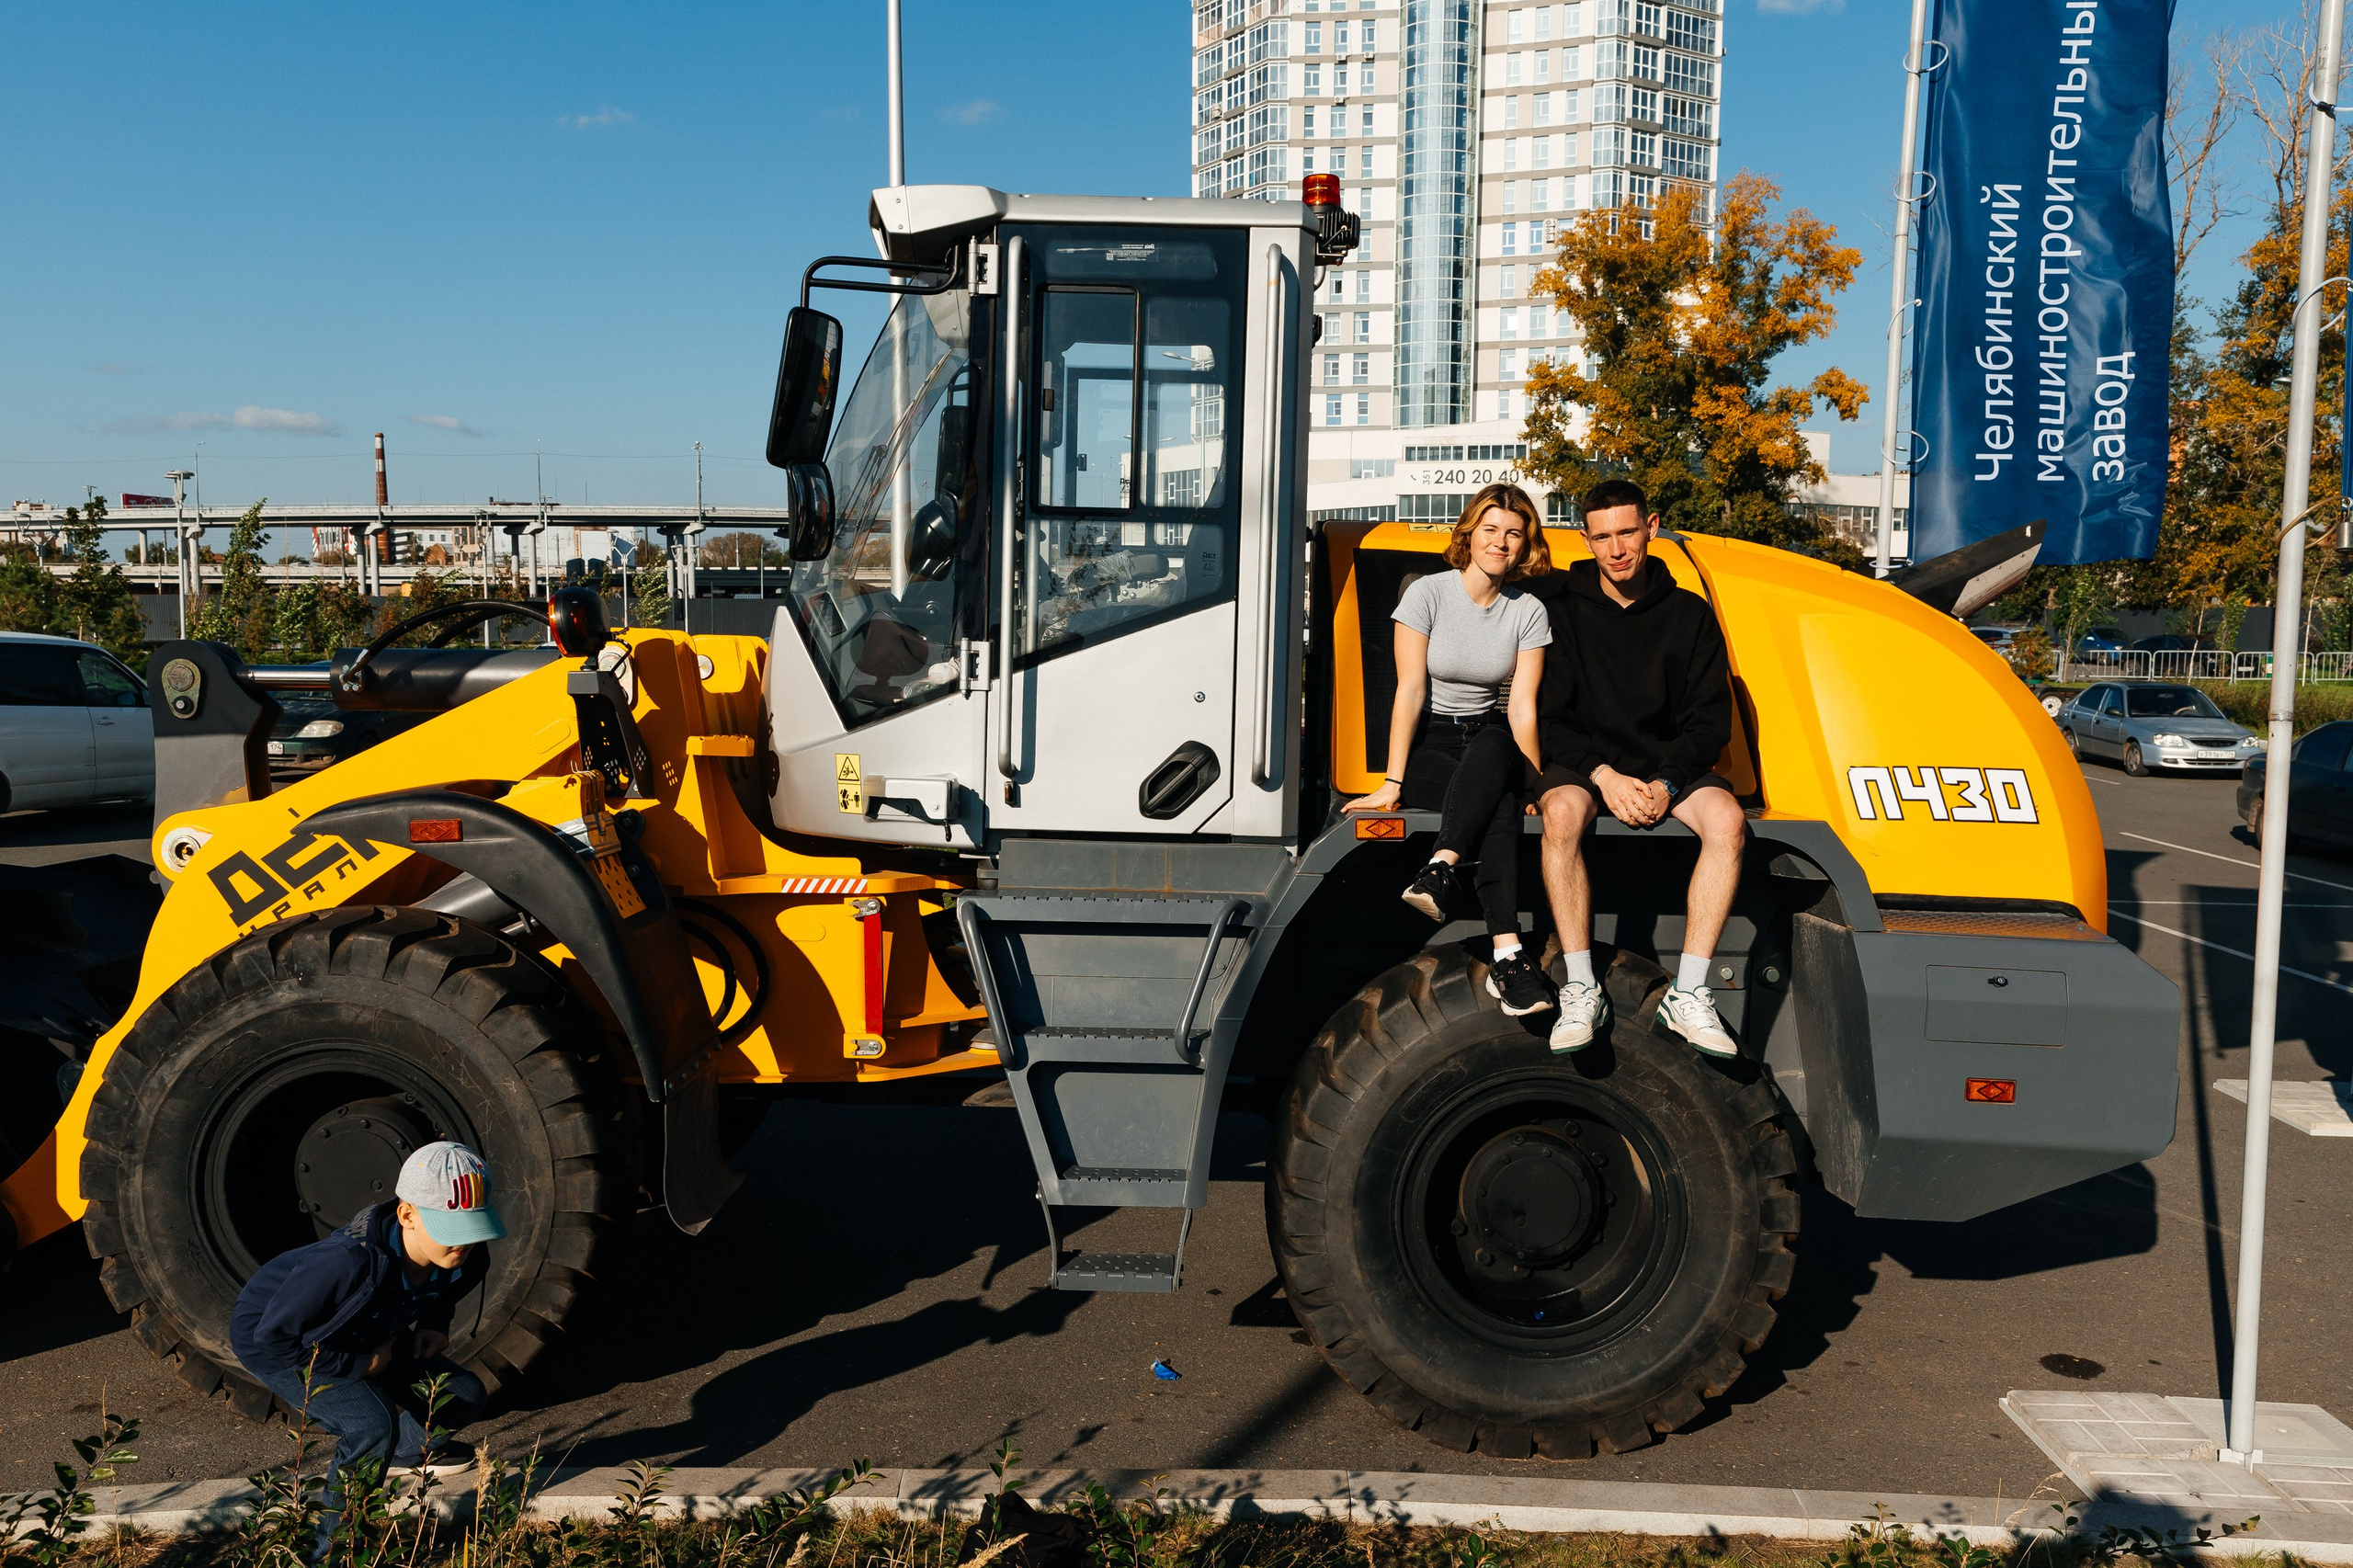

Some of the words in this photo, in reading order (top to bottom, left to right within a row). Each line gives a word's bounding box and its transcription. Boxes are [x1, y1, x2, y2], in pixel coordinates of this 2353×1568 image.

[2037, 1, 2098, 482] машиностроительны
[1974, 184, 2022, 482] Челябинский
[2092, 352, 2136, 482] завод
[1422, 470, 1431, 485] 351
[1434, 469, 1466, 484] 240
[1472, 469, 1493, 484] 20
[1498, 469, 1519, 484] 40
[238, 858, 358, 939] РАЛ
[171, 1244, 231, 1324] 7.5-25
